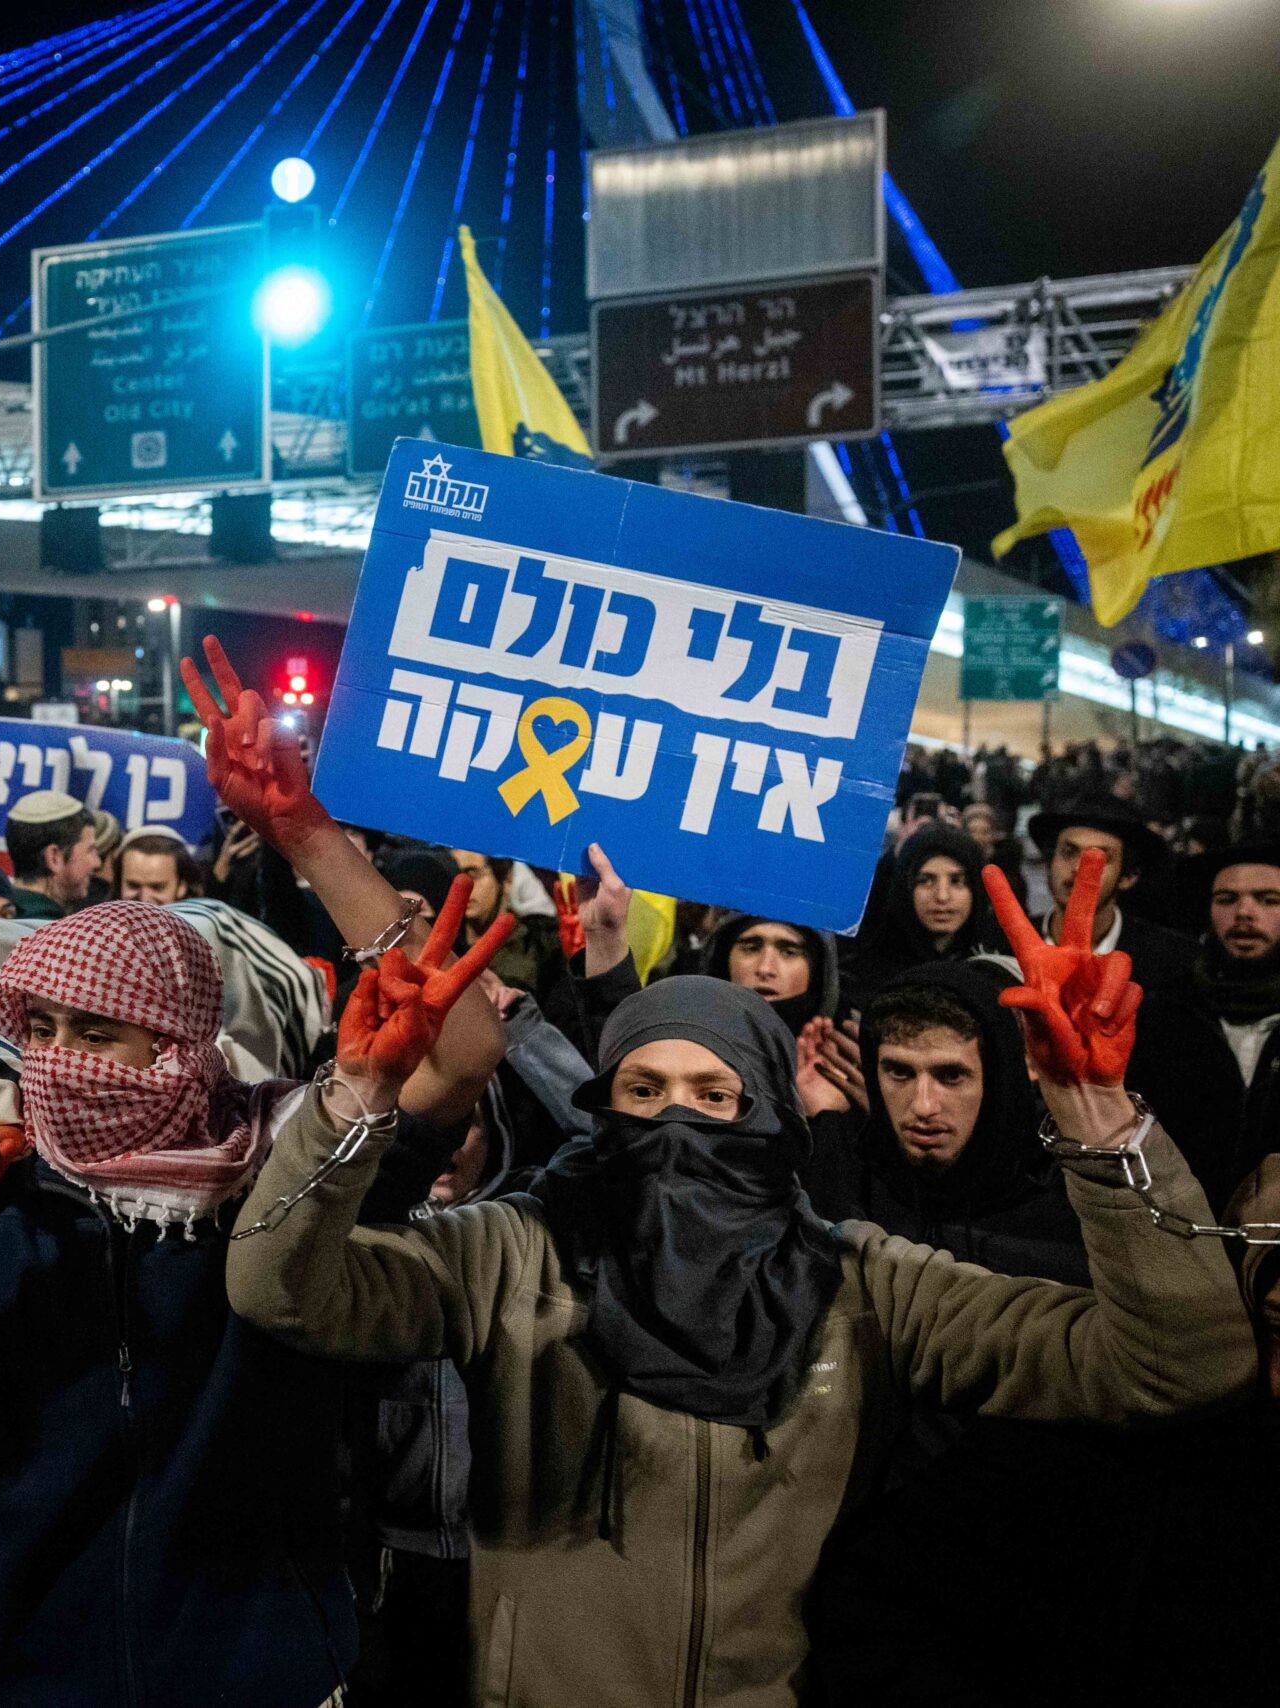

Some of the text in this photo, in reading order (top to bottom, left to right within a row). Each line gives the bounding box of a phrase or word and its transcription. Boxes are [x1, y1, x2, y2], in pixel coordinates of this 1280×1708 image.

[429, 556, 657, 677] כולם
[686, 601, 843, 719] בלי
[124, 754, 188, 830] כן
[680, 732, 844, 844] אין
